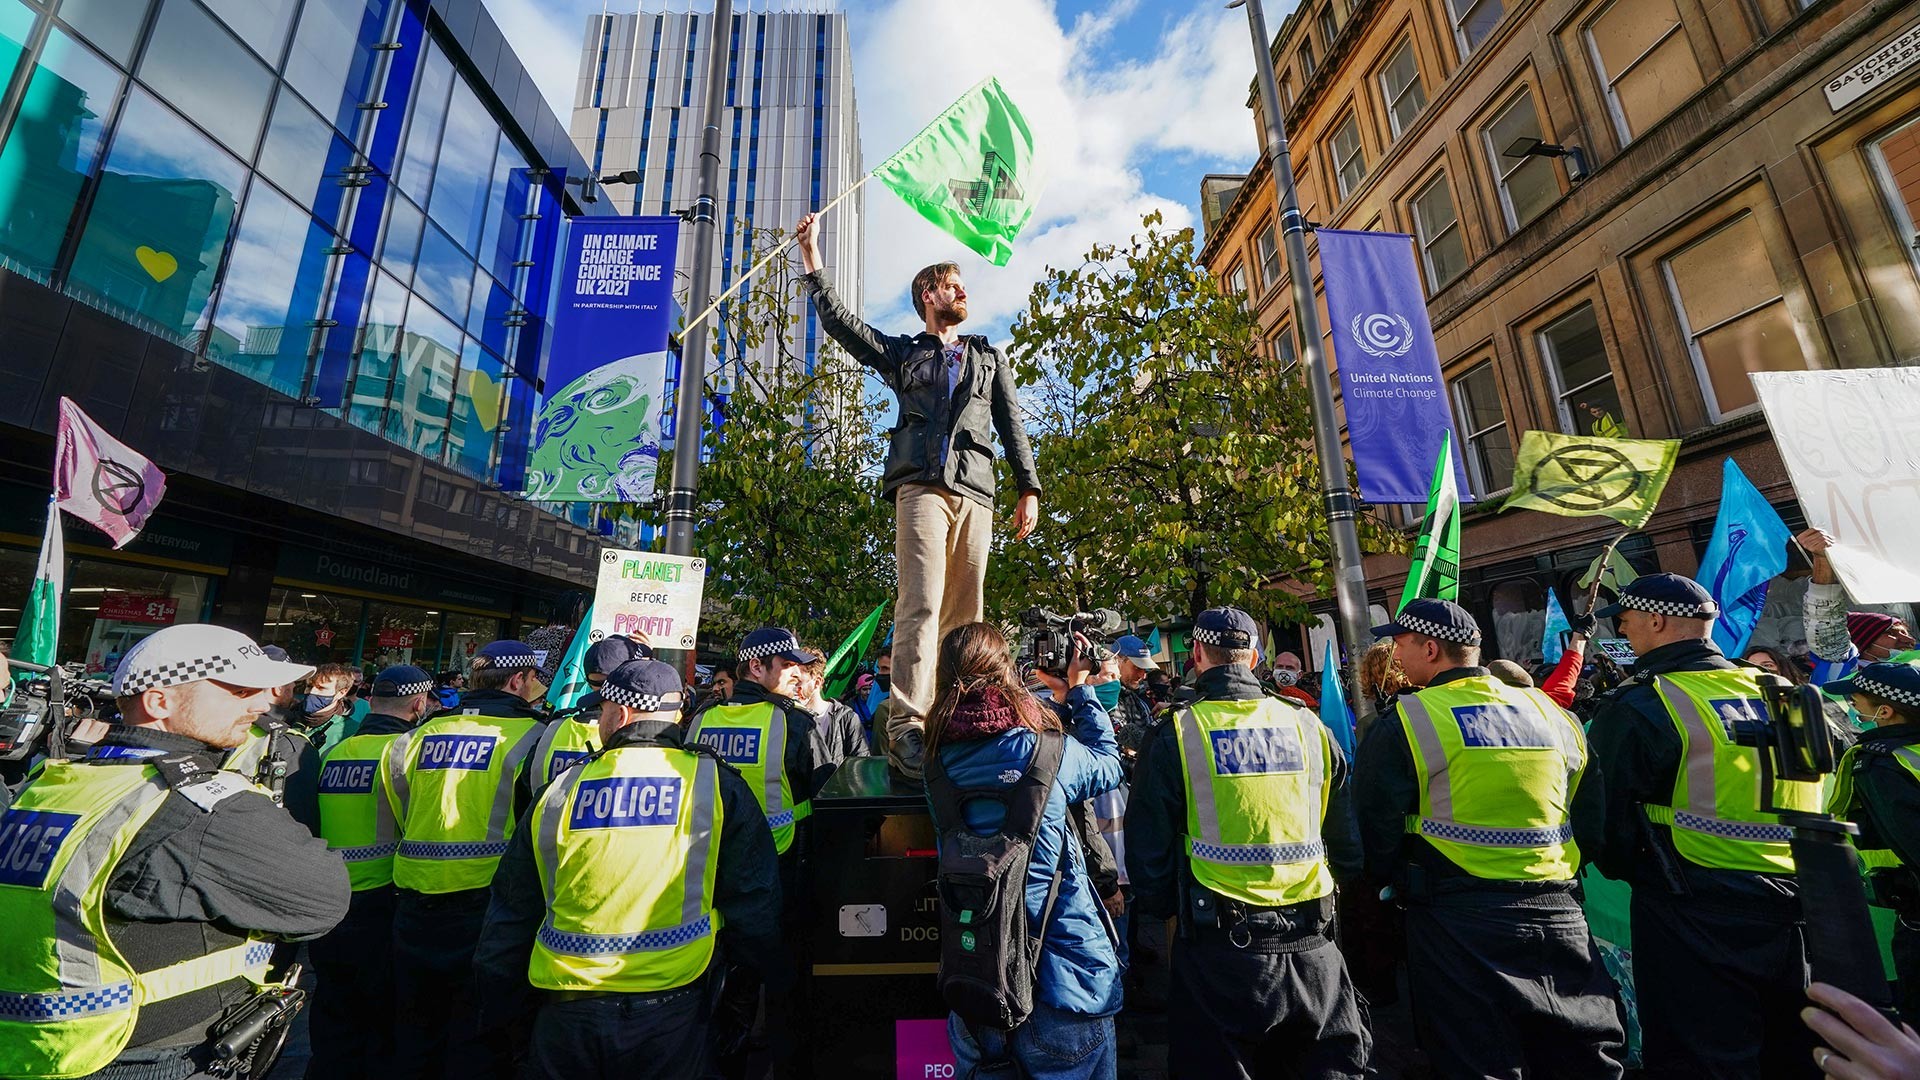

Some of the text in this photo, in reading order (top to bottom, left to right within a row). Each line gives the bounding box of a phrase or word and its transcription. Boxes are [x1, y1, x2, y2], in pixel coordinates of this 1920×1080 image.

[583, 234, 658, 250] UN CLIMATE
[580, 249, 634, 265] CHANGE
[578, 264, 662, 281] CONFERENCE
[575, 279, 630, 296] UK 2021
[1350, 373, 1434, 383] United Nations
[1353, 388, 1438, 400] Climate Change
[147, 533, 201, 551] EVERYDAY
[316, 555, 410, 589] Poundland
[622, 559, 683, 582] PLANET
[630, 592, 669, 605] BEFORE
[103, 607, 142, 617] CHRISTMAS
[614, 613, 674, 637] PROFIT
[420, 740, 492, 764] POLICE
[701, 733, 756, 758] POLICE
[1217, 736, 1299, 766] POLICE
[320, 764, 373, 788] POLICE
[576, 785, 675, 820] POLICE
[901, 927, 939, 941] DOG
[925, 1063, 955, 1079] PEO
